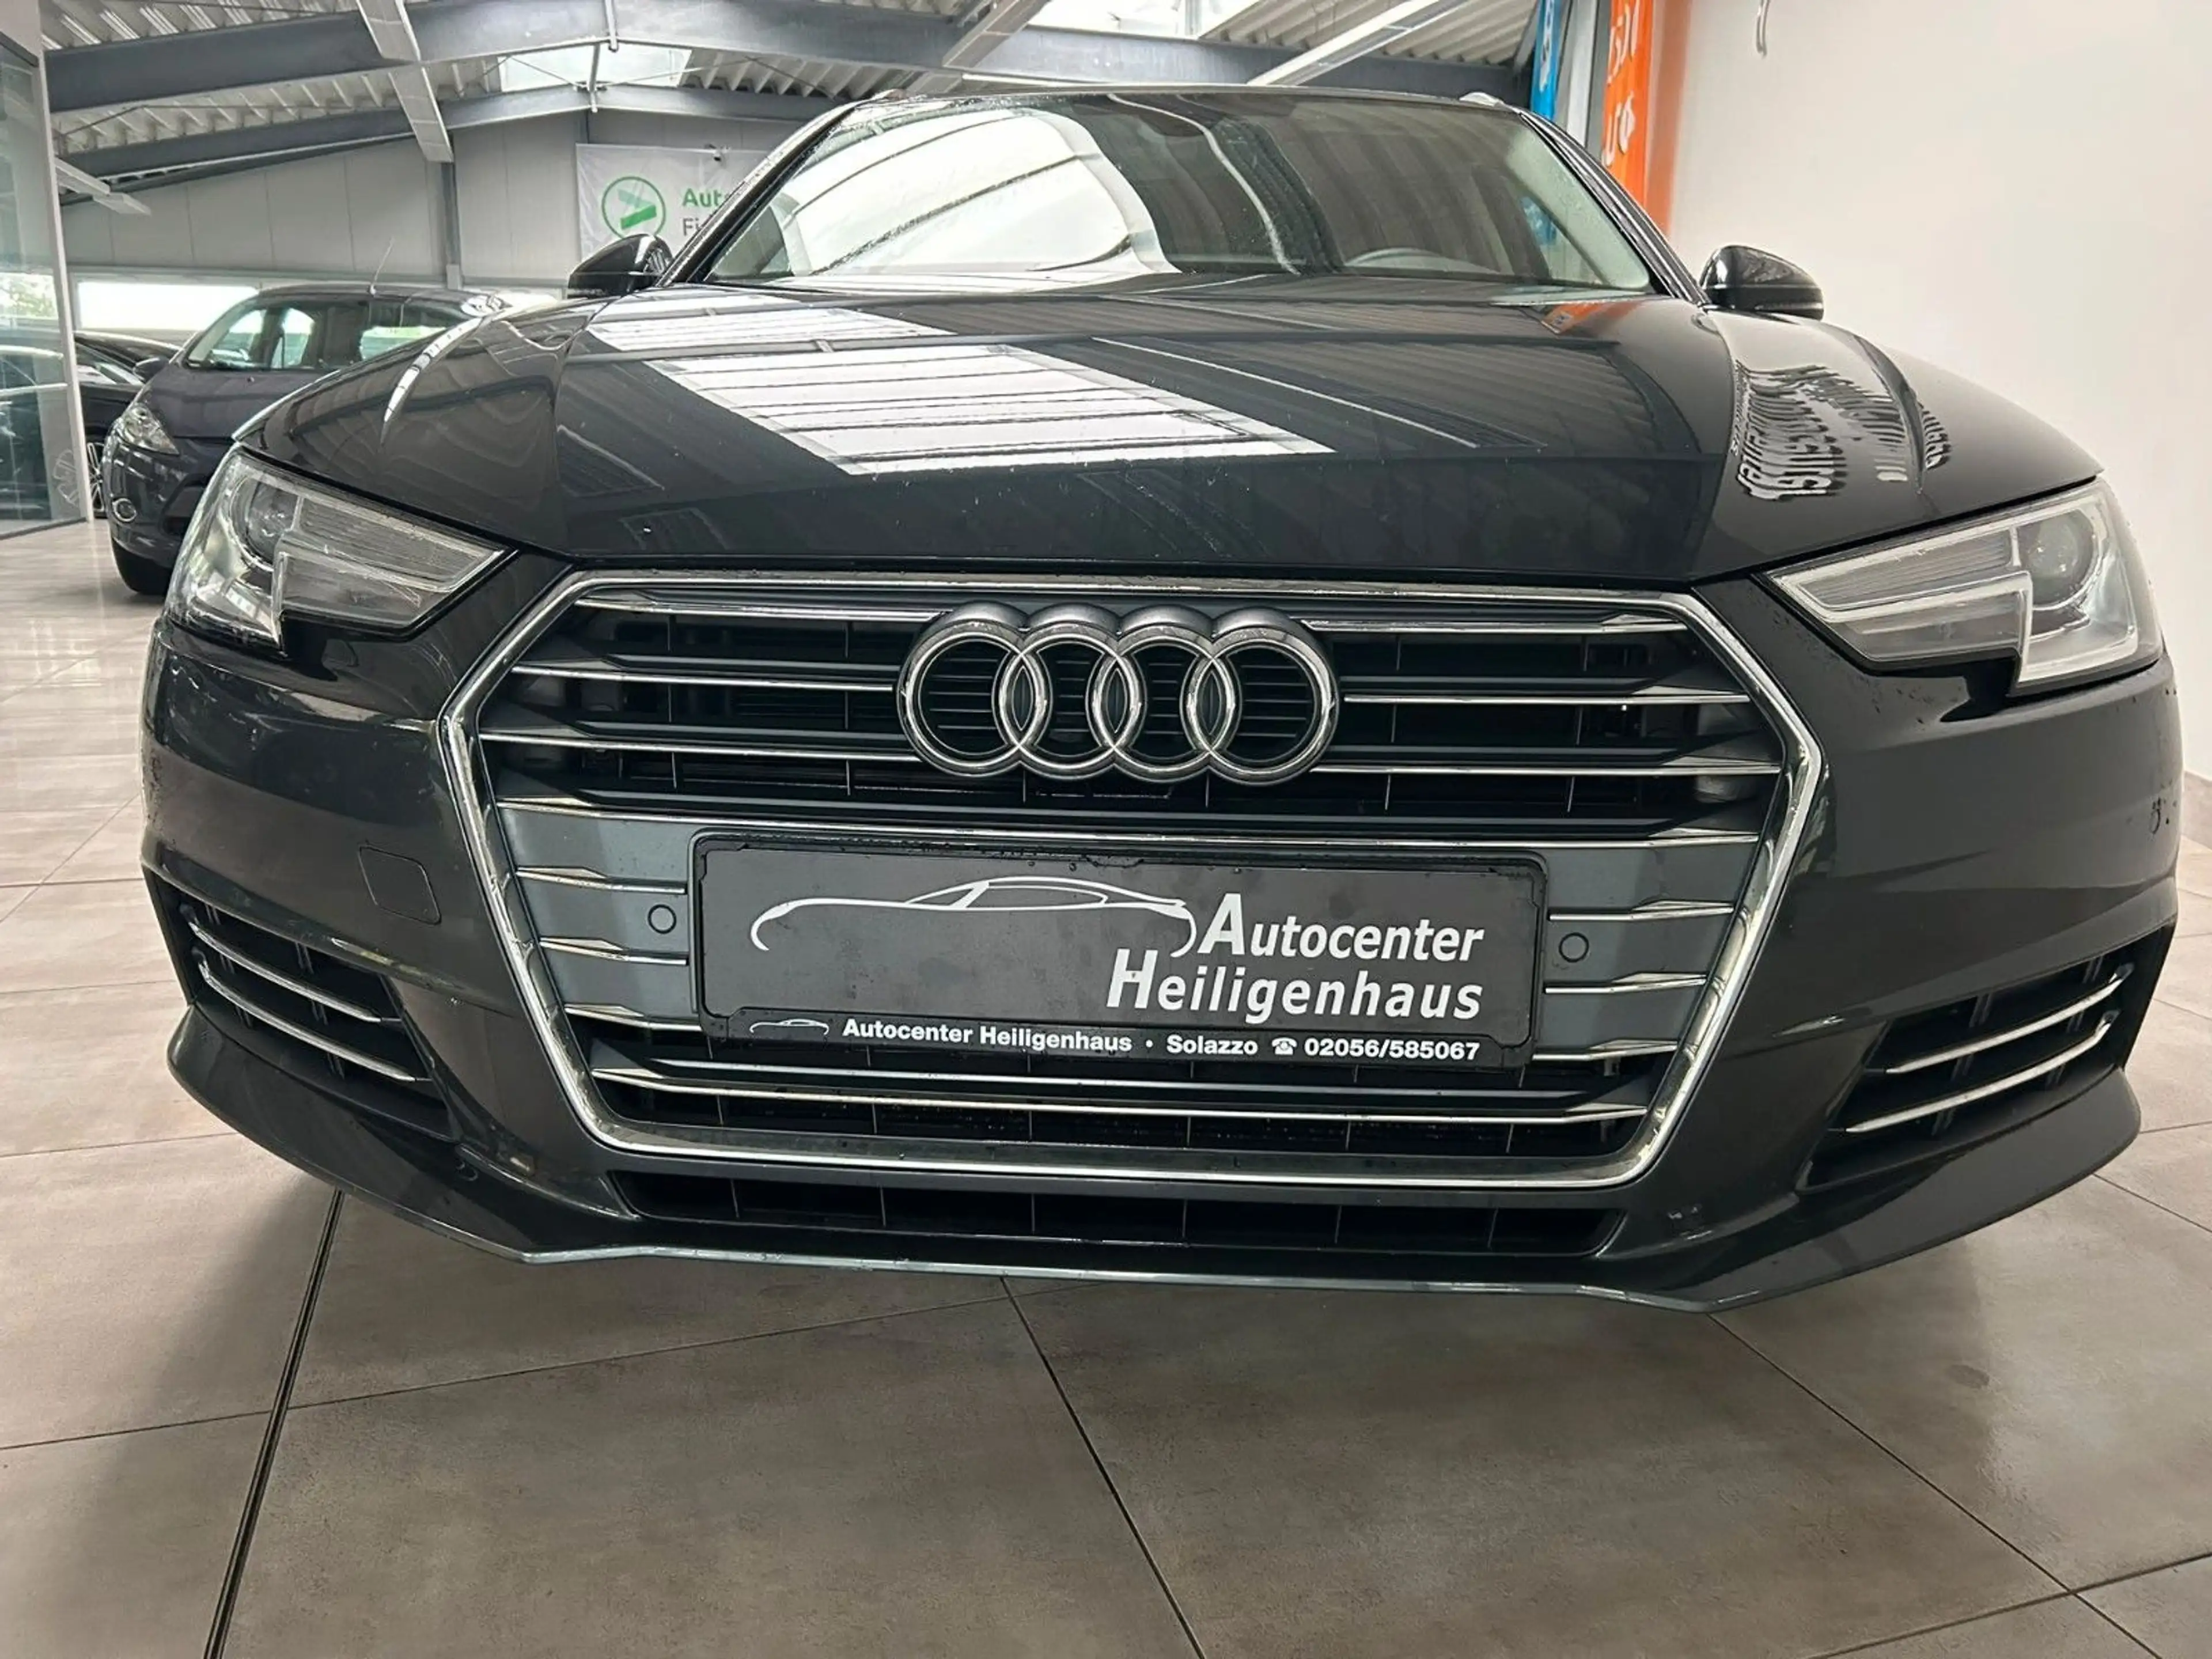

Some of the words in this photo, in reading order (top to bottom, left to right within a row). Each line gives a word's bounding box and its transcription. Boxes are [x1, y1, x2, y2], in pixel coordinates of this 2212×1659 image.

[682, 188, 728, 207] Aut
[1197, 893, 1484, 961] Autocenter
[1106, 948, 1483, 1024] Heiligenhaus
[842, 1018, 974, 1043] Autocenter
[980, 1025, 1132, 1052] Heiligenhaus
[1166, 1035, 1258, 1055] Solazzo
[1304, 1037, 1480, 1060] 02056/585067
